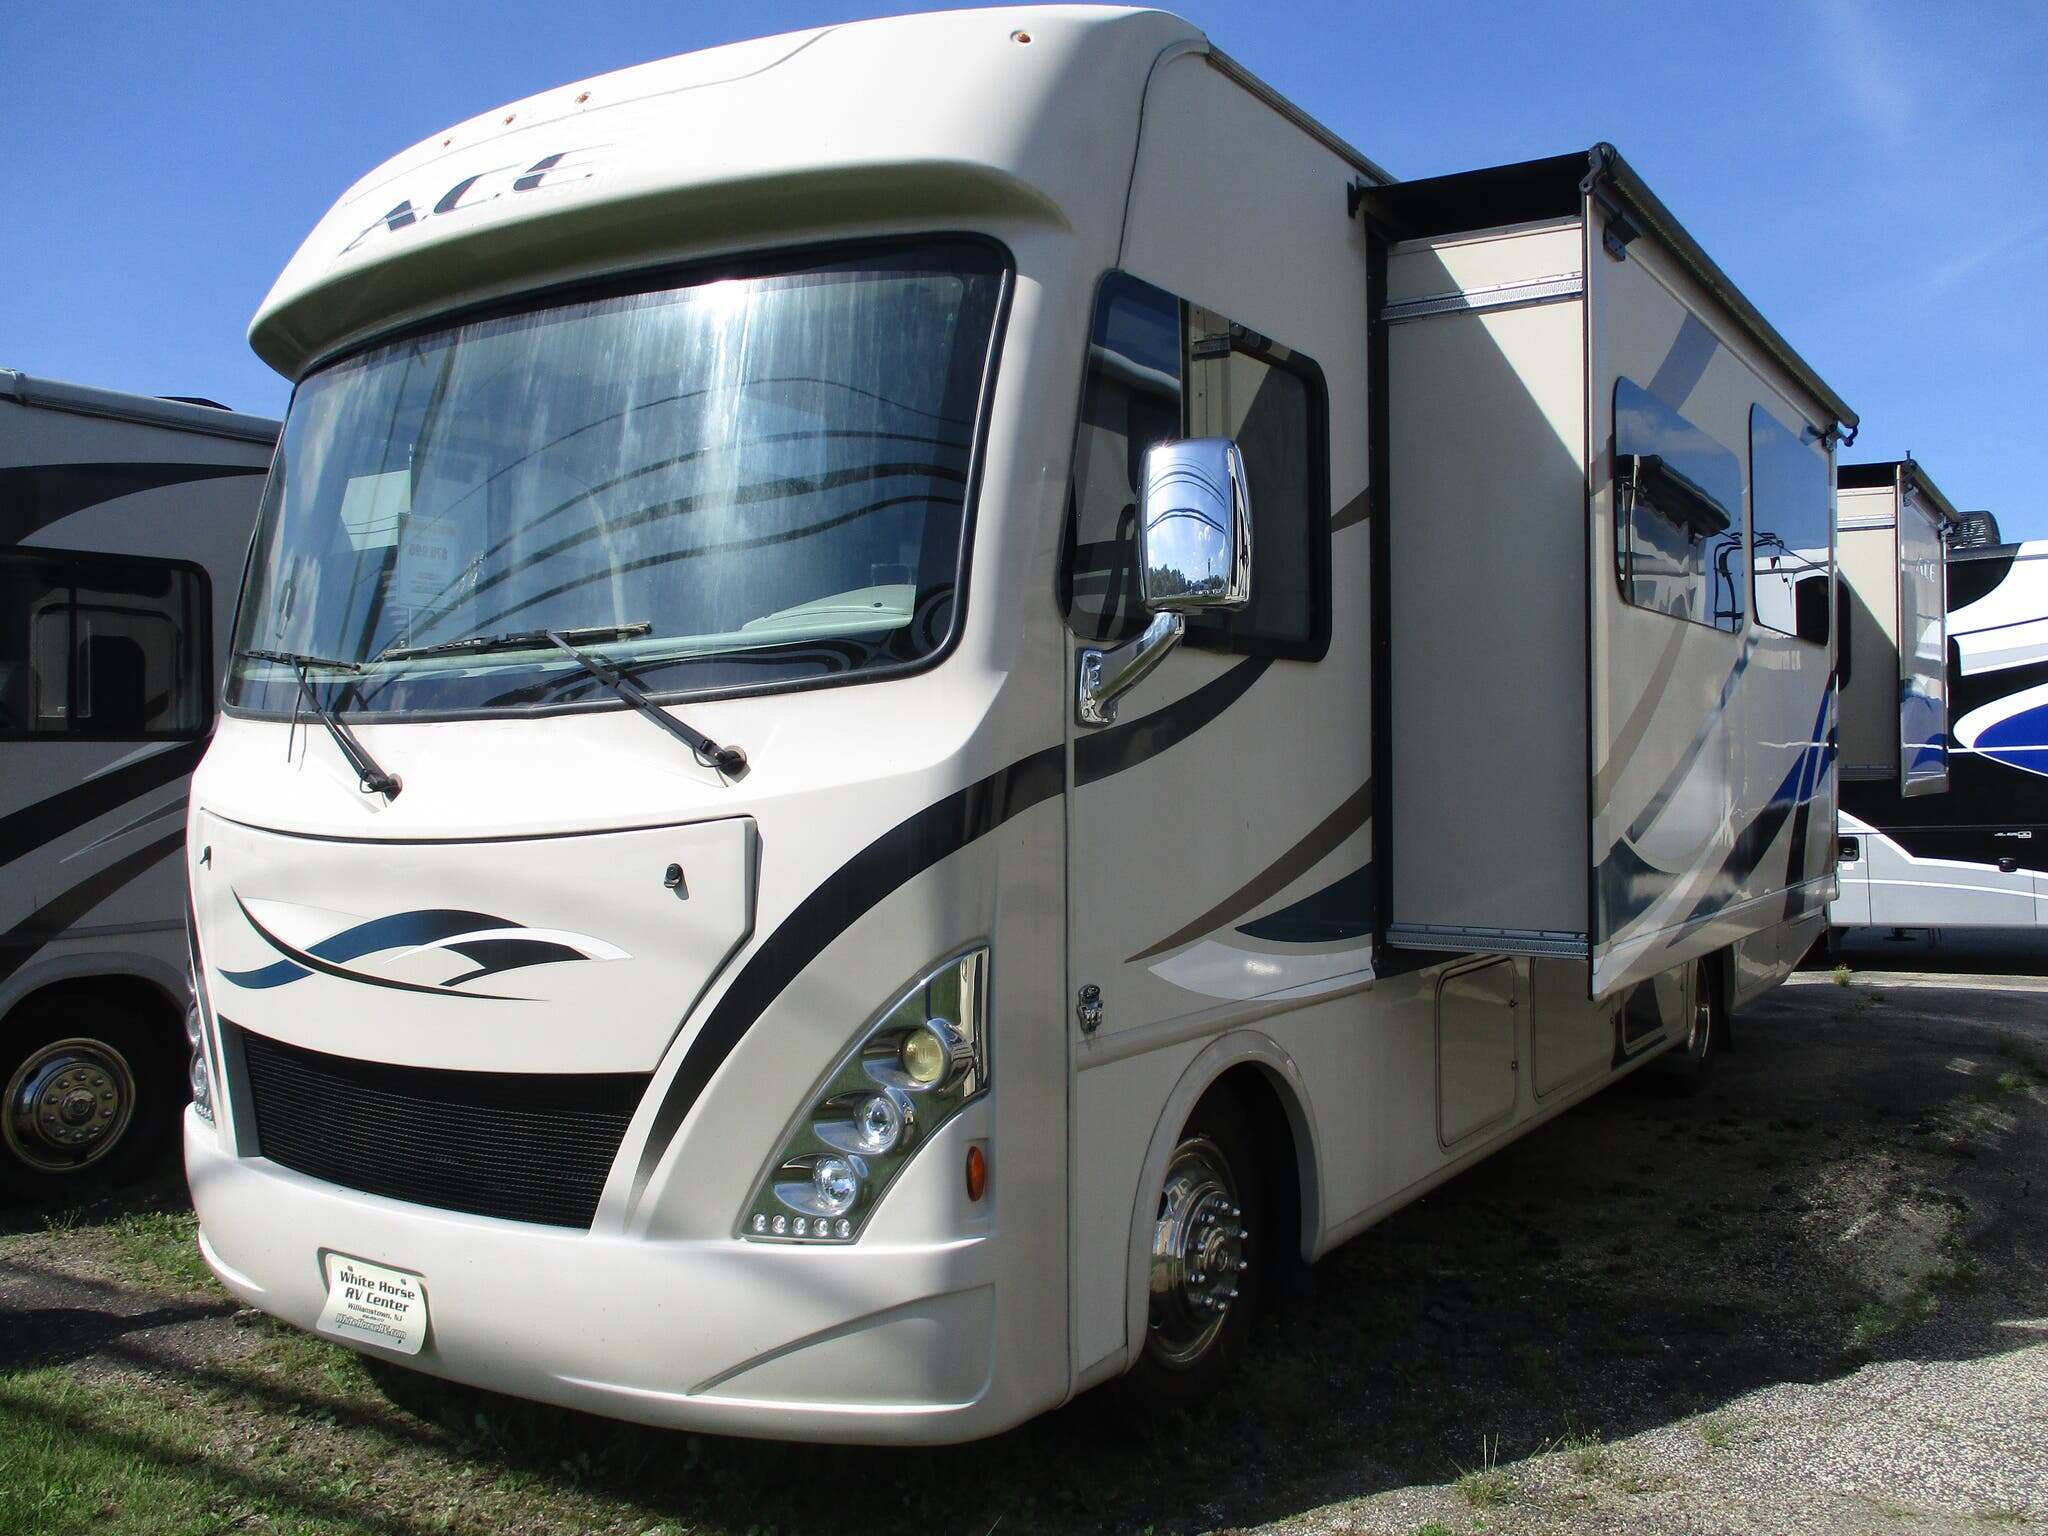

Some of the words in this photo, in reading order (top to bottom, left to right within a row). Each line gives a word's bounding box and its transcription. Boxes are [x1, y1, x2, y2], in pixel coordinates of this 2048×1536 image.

[340, 1270, 375, 1289] White
[379, 1281, 415, 1300] Horse
[345, 1286, 364, 1300] RV
[366, 1292, 410, 1313] Center
[348, 1302, 392, 1319] Williamstown,
[394, 1313, 403, 1322] NJ
